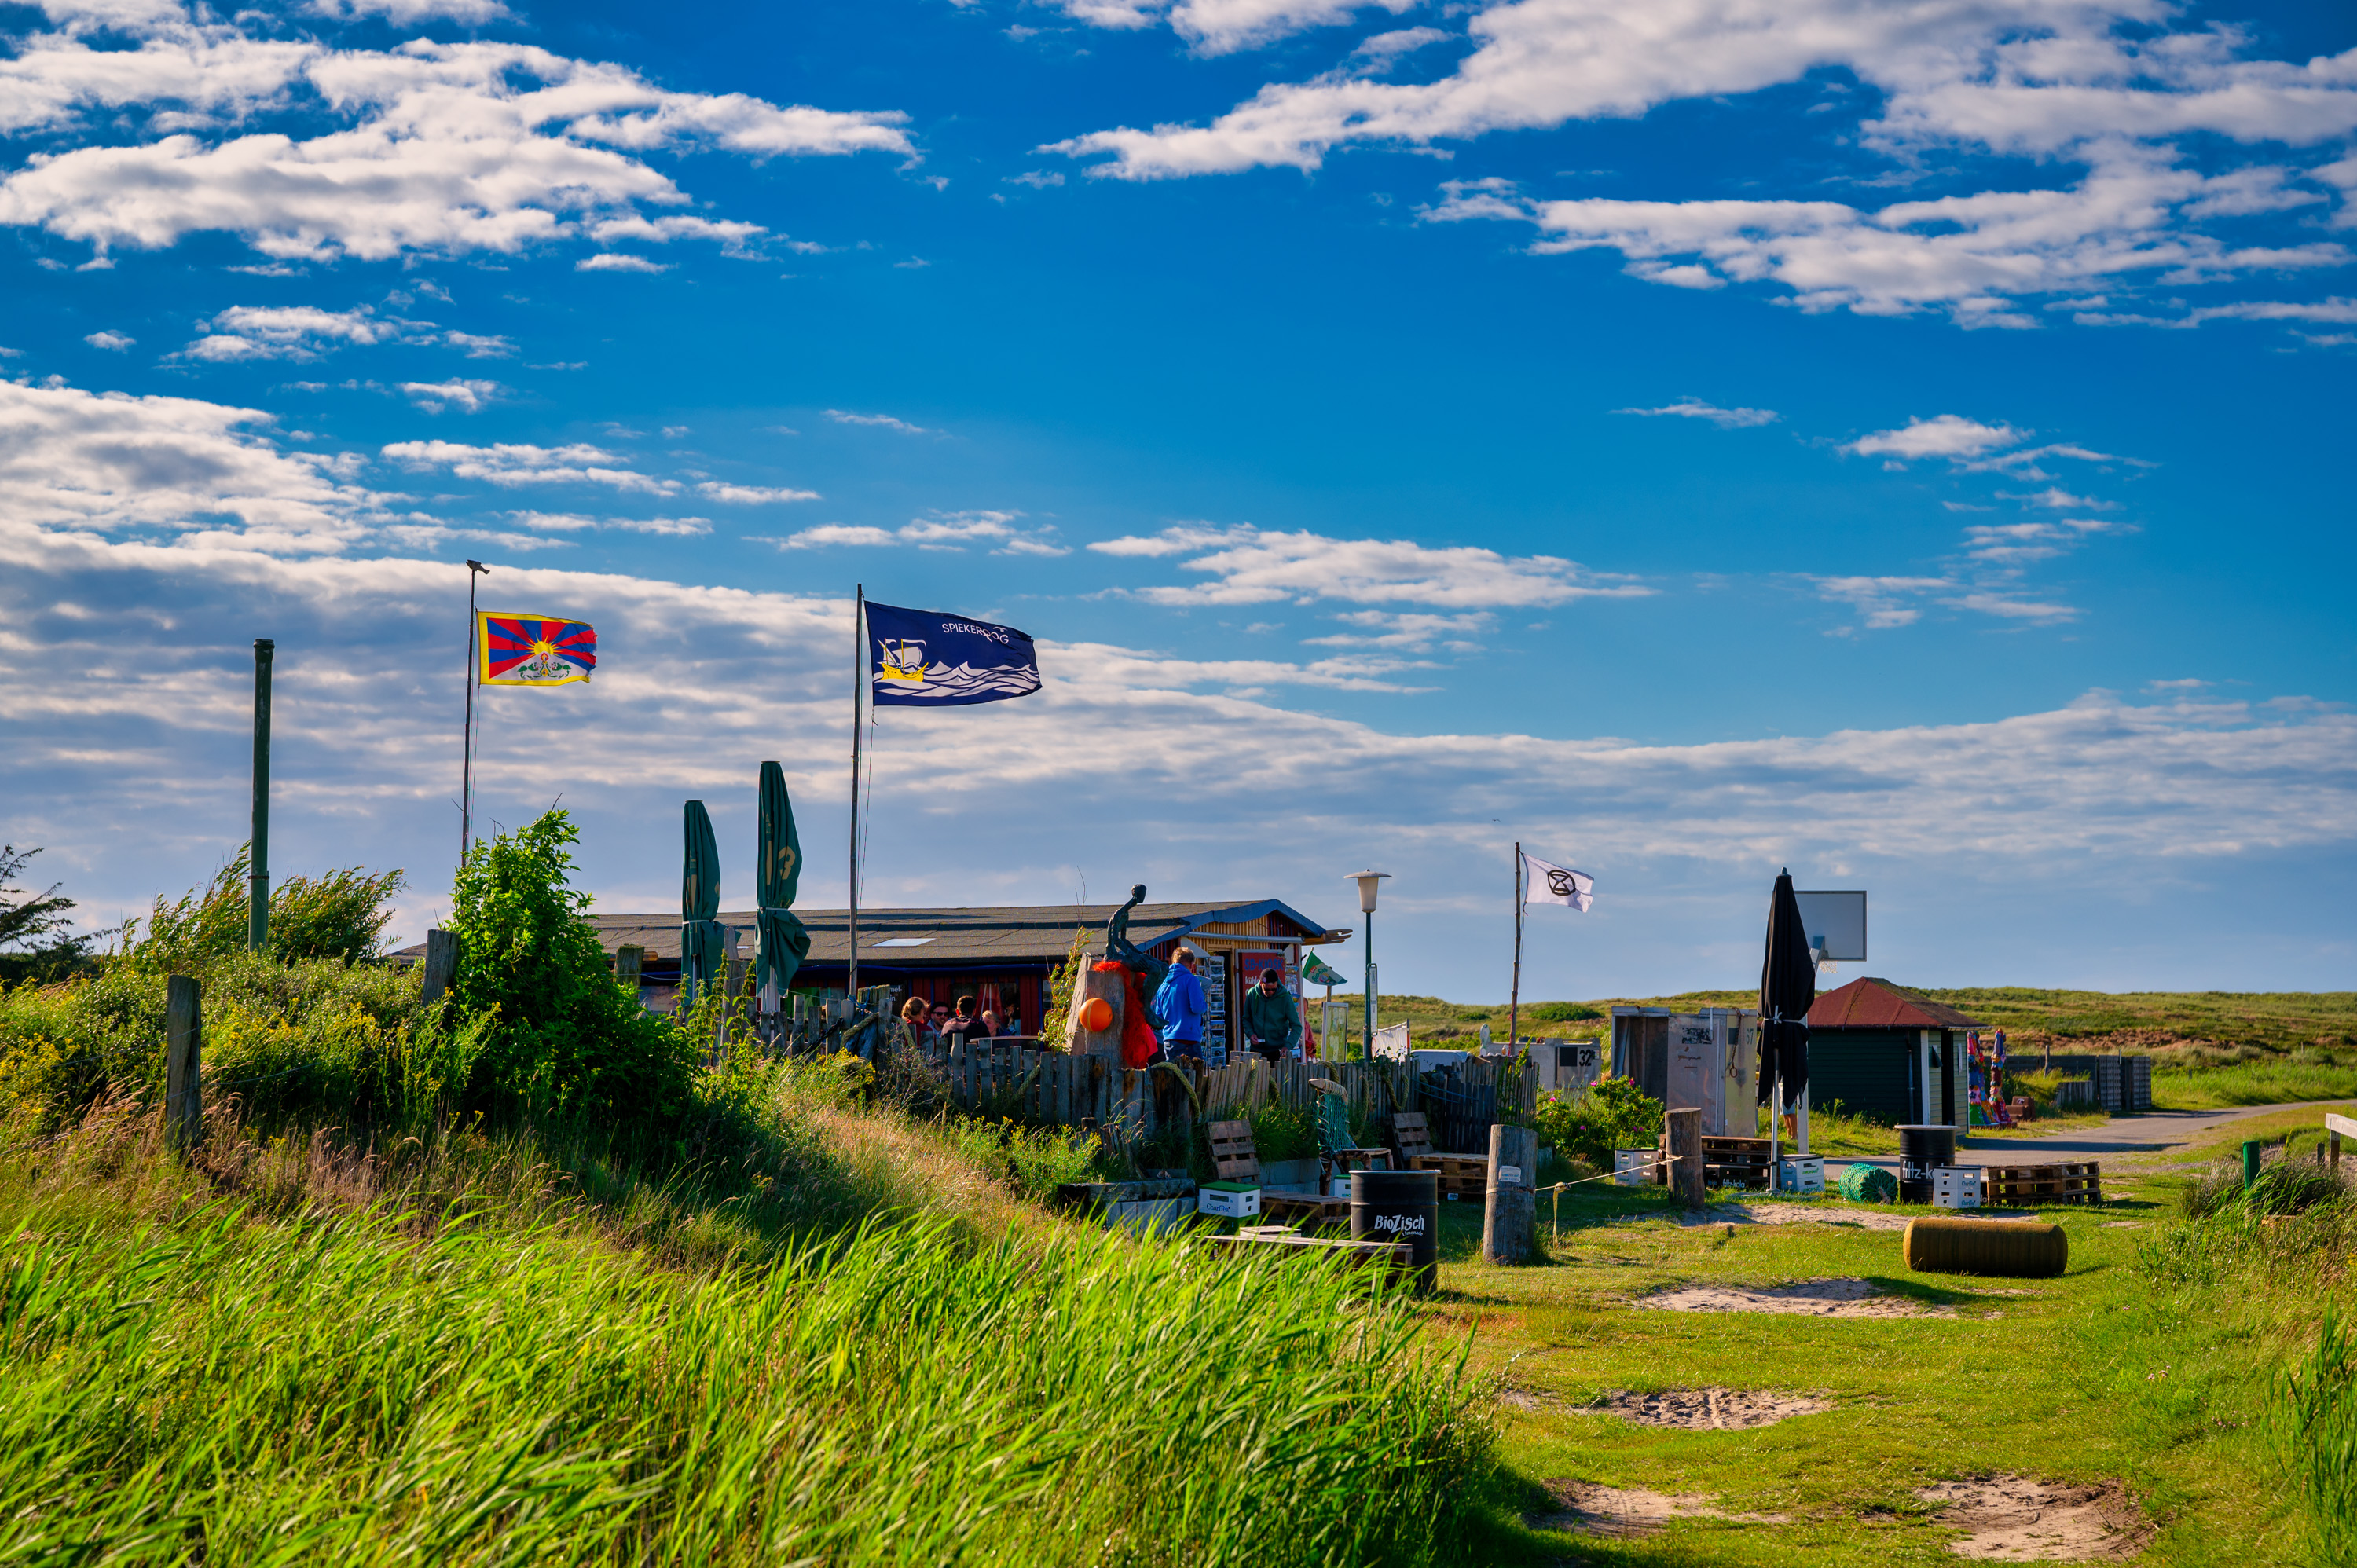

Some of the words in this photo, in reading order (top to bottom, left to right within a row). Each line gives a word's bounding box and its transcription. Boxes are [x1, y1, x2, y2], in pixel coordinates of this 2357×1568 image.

[942, 623, 1009, 644] SPIEKEROOG
[1244, 958, 1284, 971] SB-KIOSK
[1746, 1028, 1754, 1045] 67
[1578, 1049, 1592, 1067] 32
[1902, 1160, 1941, 1179] fritz-k
